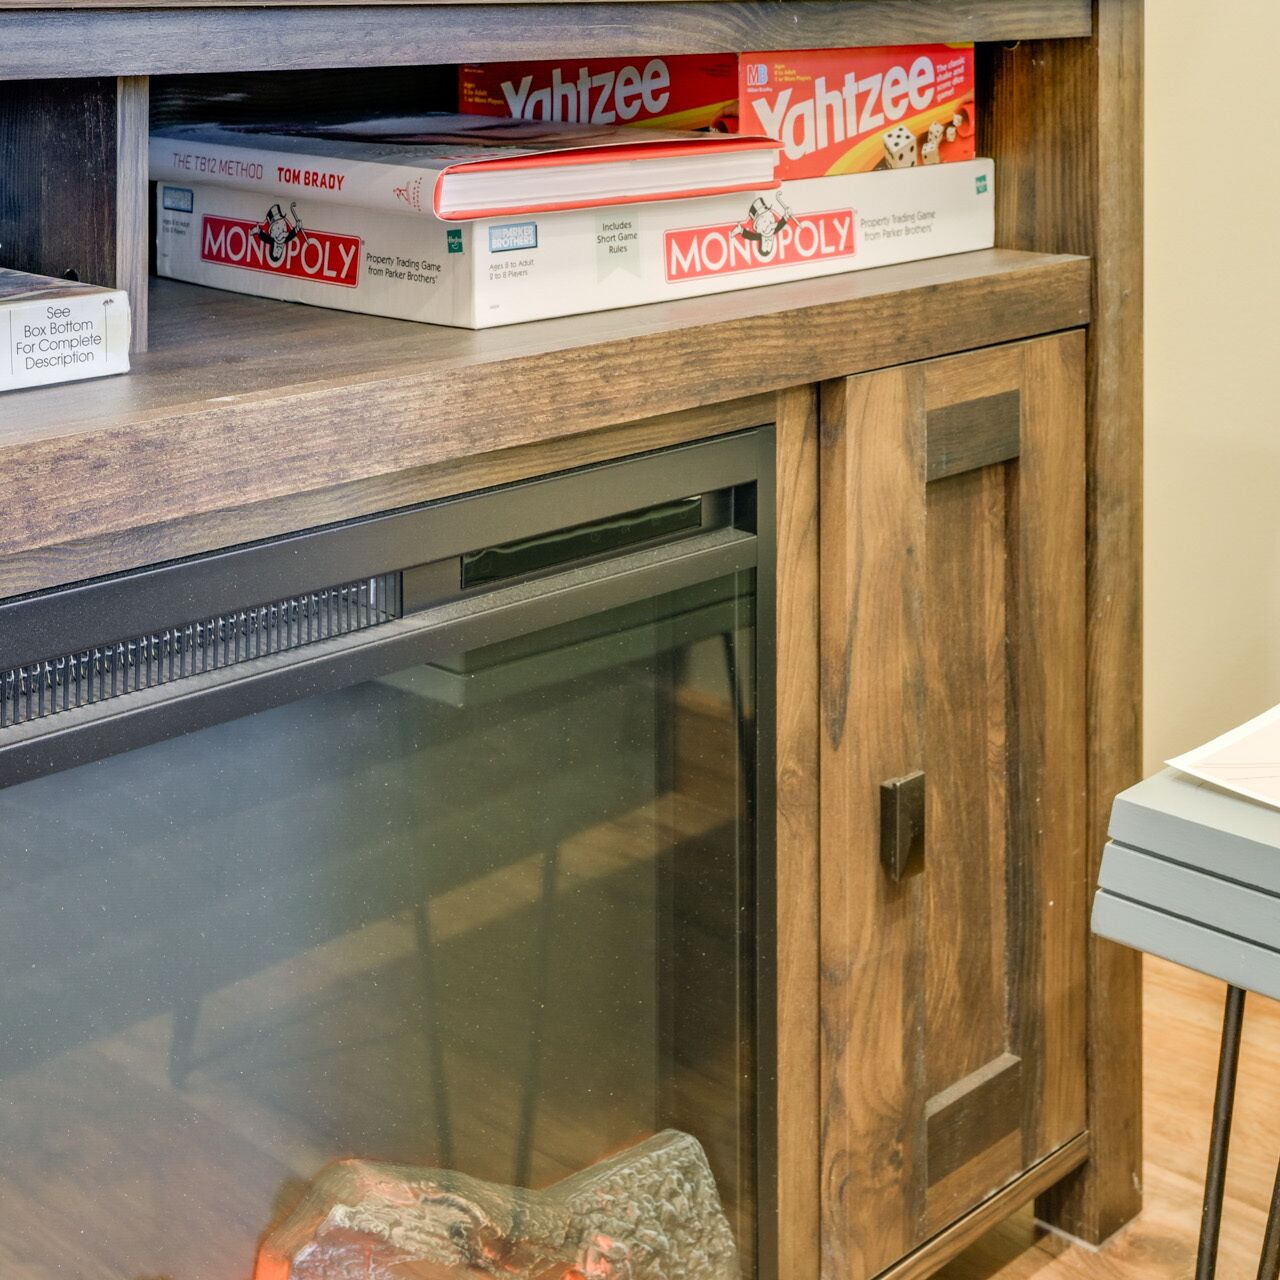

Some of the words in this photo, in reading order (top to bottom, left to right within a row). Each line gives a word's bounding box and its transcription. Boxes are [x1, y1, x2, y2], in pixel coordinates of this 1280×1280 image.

[747, 64, 768, 85] MB
[501, 58, 670, 125] Yahtzee
[751, 56, 935, 166] Yahtzee
[173, 153, 192, 169] THE
[194, 156, 216, 173] TB12
[220, 159, 264, 180] METHOD
[277, 167, 302, 185] TOM
[303, 170, 346, 191] BRADY
[602, 220, 632, 232] Includes
[892, 213, 916, 224] Trading
[916, 210, 936, 220] Game
[491, 235, 534, 248] BROTHERS
[597, 233, 621, 244] Short
[622, 232, 638, 242] Game
[882, 227, 903, 239] Parker
[204, 223, 356, 279] MONOPOLY
[608, 244, 628, 254] Rules
[671, 216, 851, 275] MONOPOLY
[366, 252, 394, 267] Property
[396, 257, 419, 271] Trading
[421, 260, 441, 272] Game
[489, 263, 504, 272] Ages
[519, 259, 535, 267] Adult
[368, 266, 383, 277] from
[384, 269, 406, 280] Parker
[407, 272, 436, 284] Brothers
[494, 272, 502, 280] to
[47, 306, 71, 320] See
[24, 325, 47, 338] Box
[50, 320, 94, 335] Bottom
[16, 342, 36, 355] For
[38, 333, 102, 352] Complete
[25, 351, 95, 370] Description
